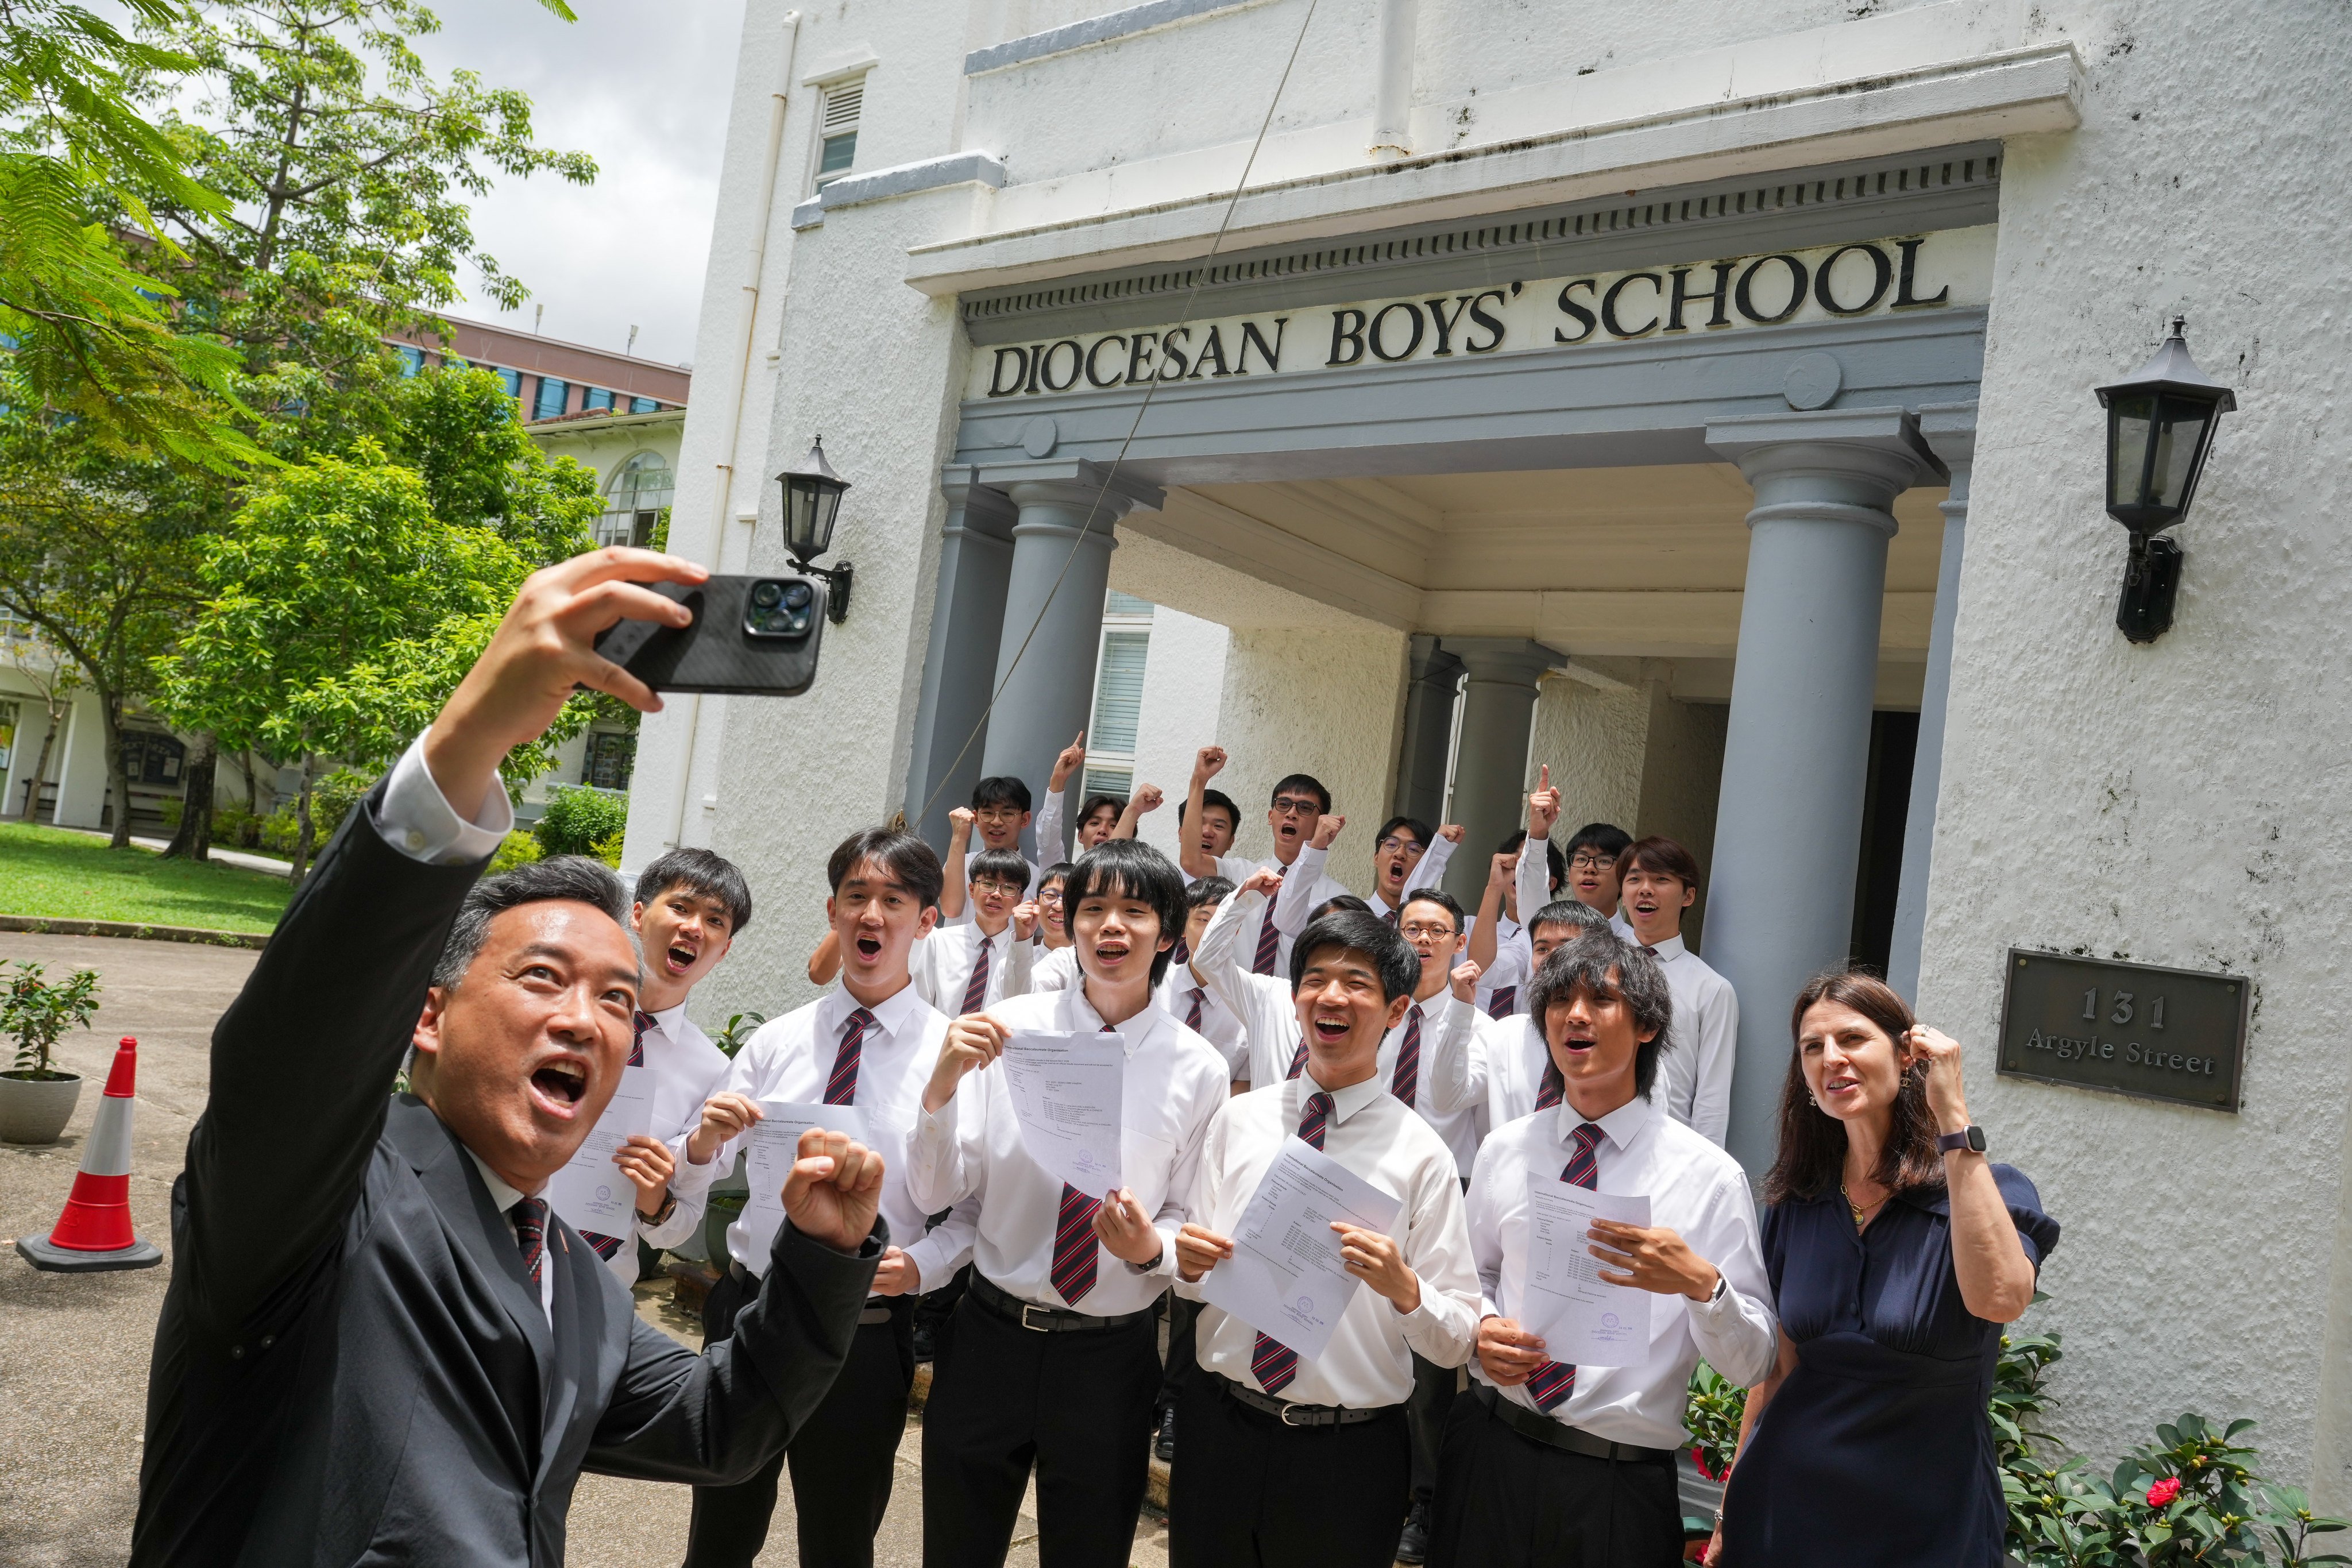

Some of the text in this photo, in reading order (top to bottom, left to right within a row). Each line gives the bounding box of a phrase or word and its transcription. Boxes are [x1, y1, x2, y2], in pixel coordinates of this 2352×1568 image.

[988, 238, 1949, 397] DIOCESAN BOYS' SCHOOL
[2026, 1028, 2215, 1075] Argyle Street
[1285, 1153, 1304, 1166] International
[1303, 1164, 1324, 1179] Baccalaureate
[1323, 1177, 1343, 1192] Organisation
[1554, 1195, 1574, 1203] Baccalaureate
[1575, 1201, 1594, 1209] Organisation
